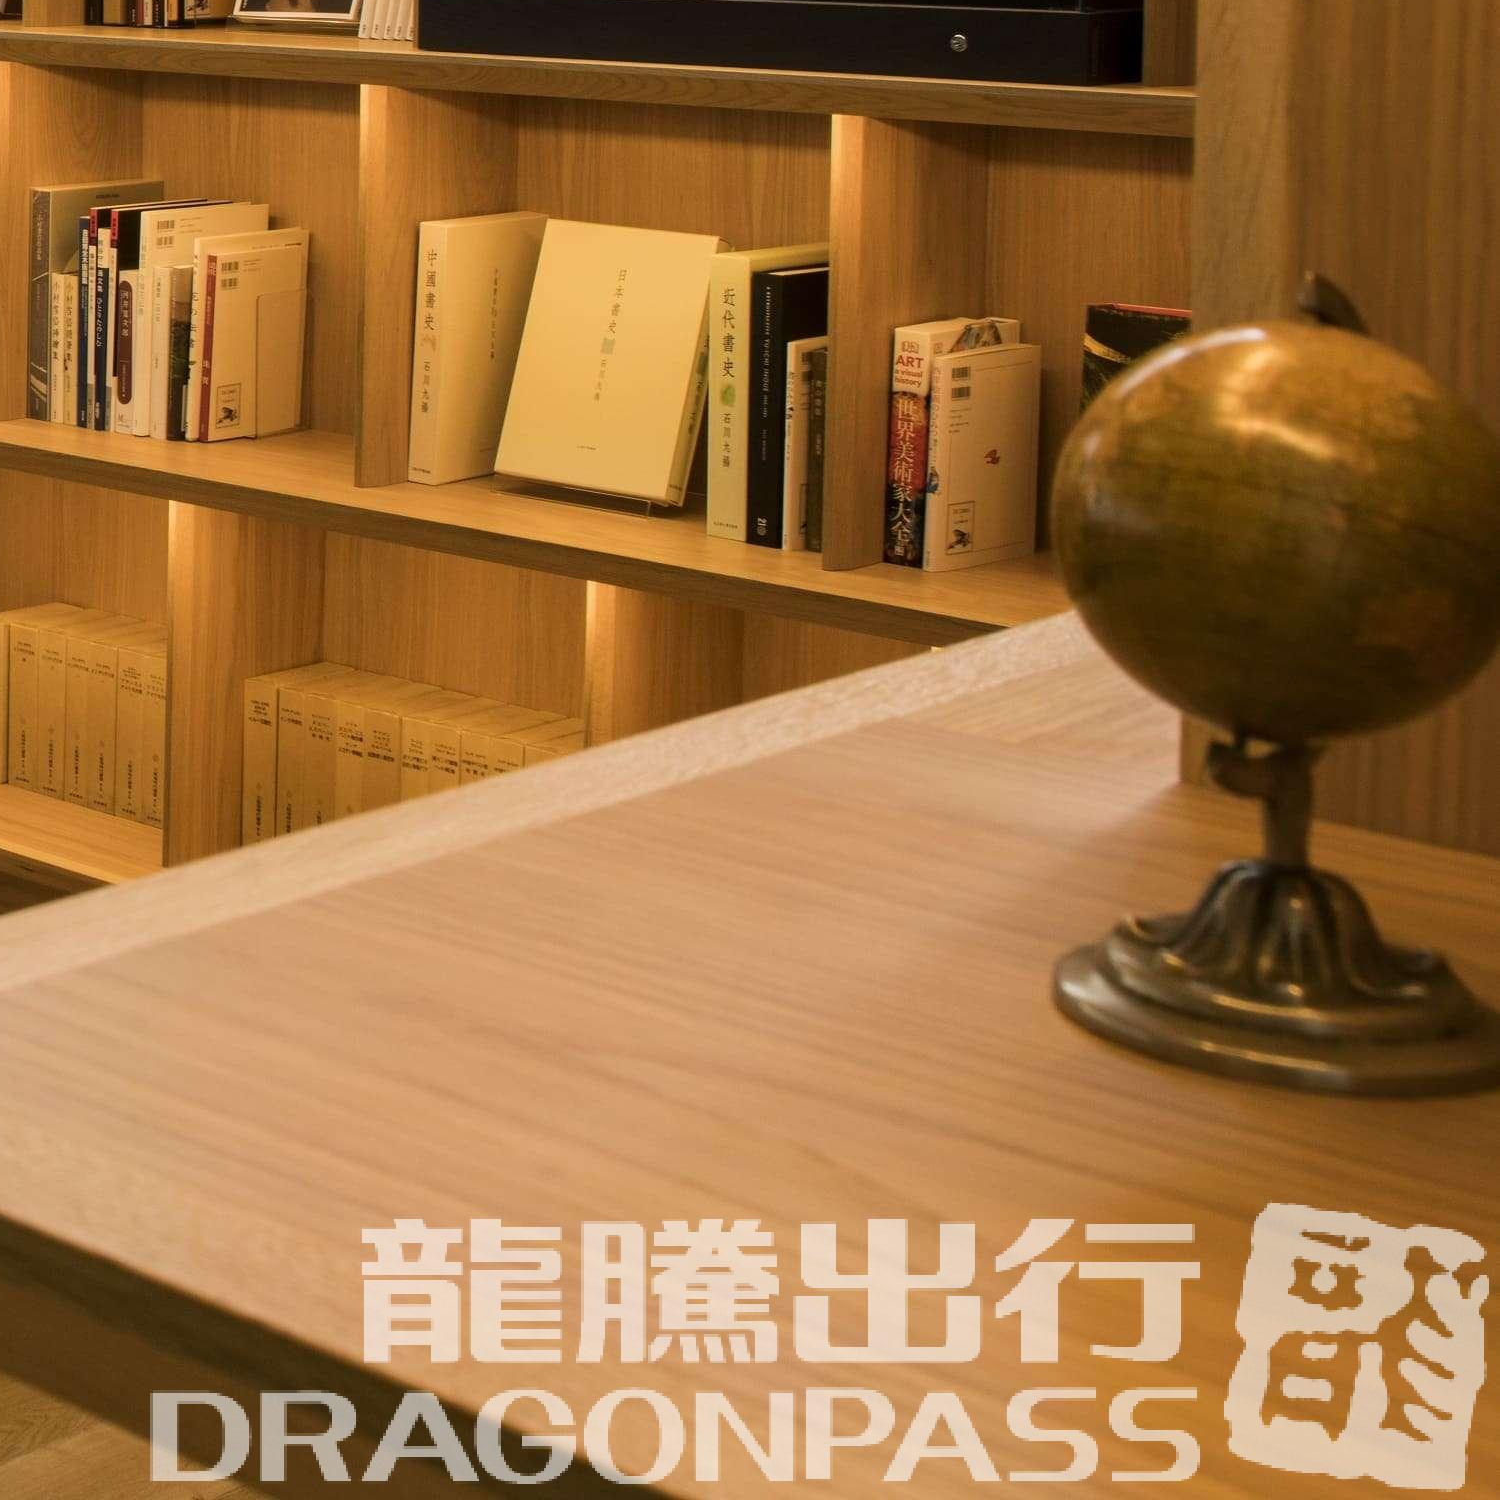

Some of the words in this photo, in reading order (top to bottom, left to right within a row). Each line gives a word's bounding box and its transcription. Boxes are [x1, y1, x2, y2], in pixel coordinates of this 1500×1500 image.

[721, 287, 735, 378] 近代書史
[895, 355, 924, 369] ART
[890, 399, 914, 541] 世界美術家大全
